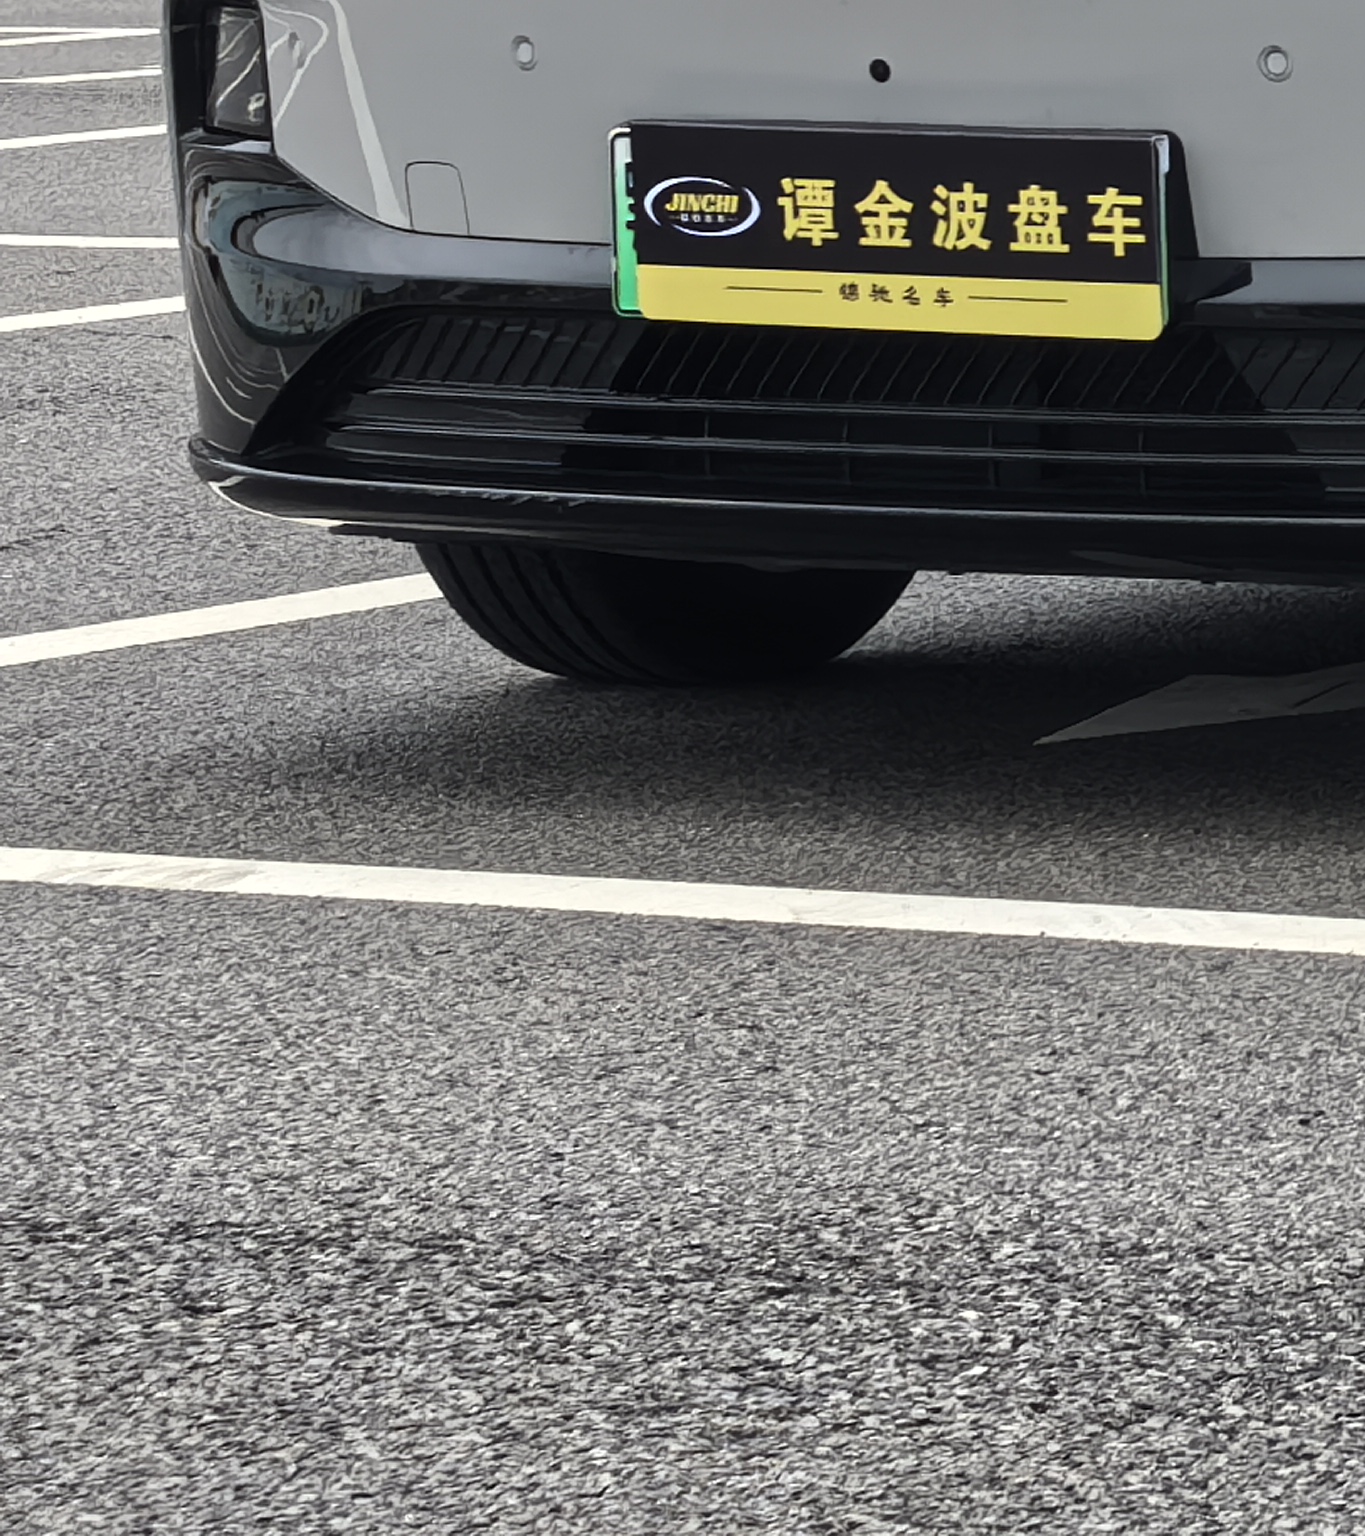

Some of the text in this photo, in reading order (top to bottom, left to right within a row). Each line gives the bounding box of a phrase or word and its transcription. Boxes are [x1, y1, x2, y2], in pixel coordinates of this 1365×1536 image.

[664, 192, 740, 214] JINCHI
[777, 176, 1147, 257] 谭金波盘车
